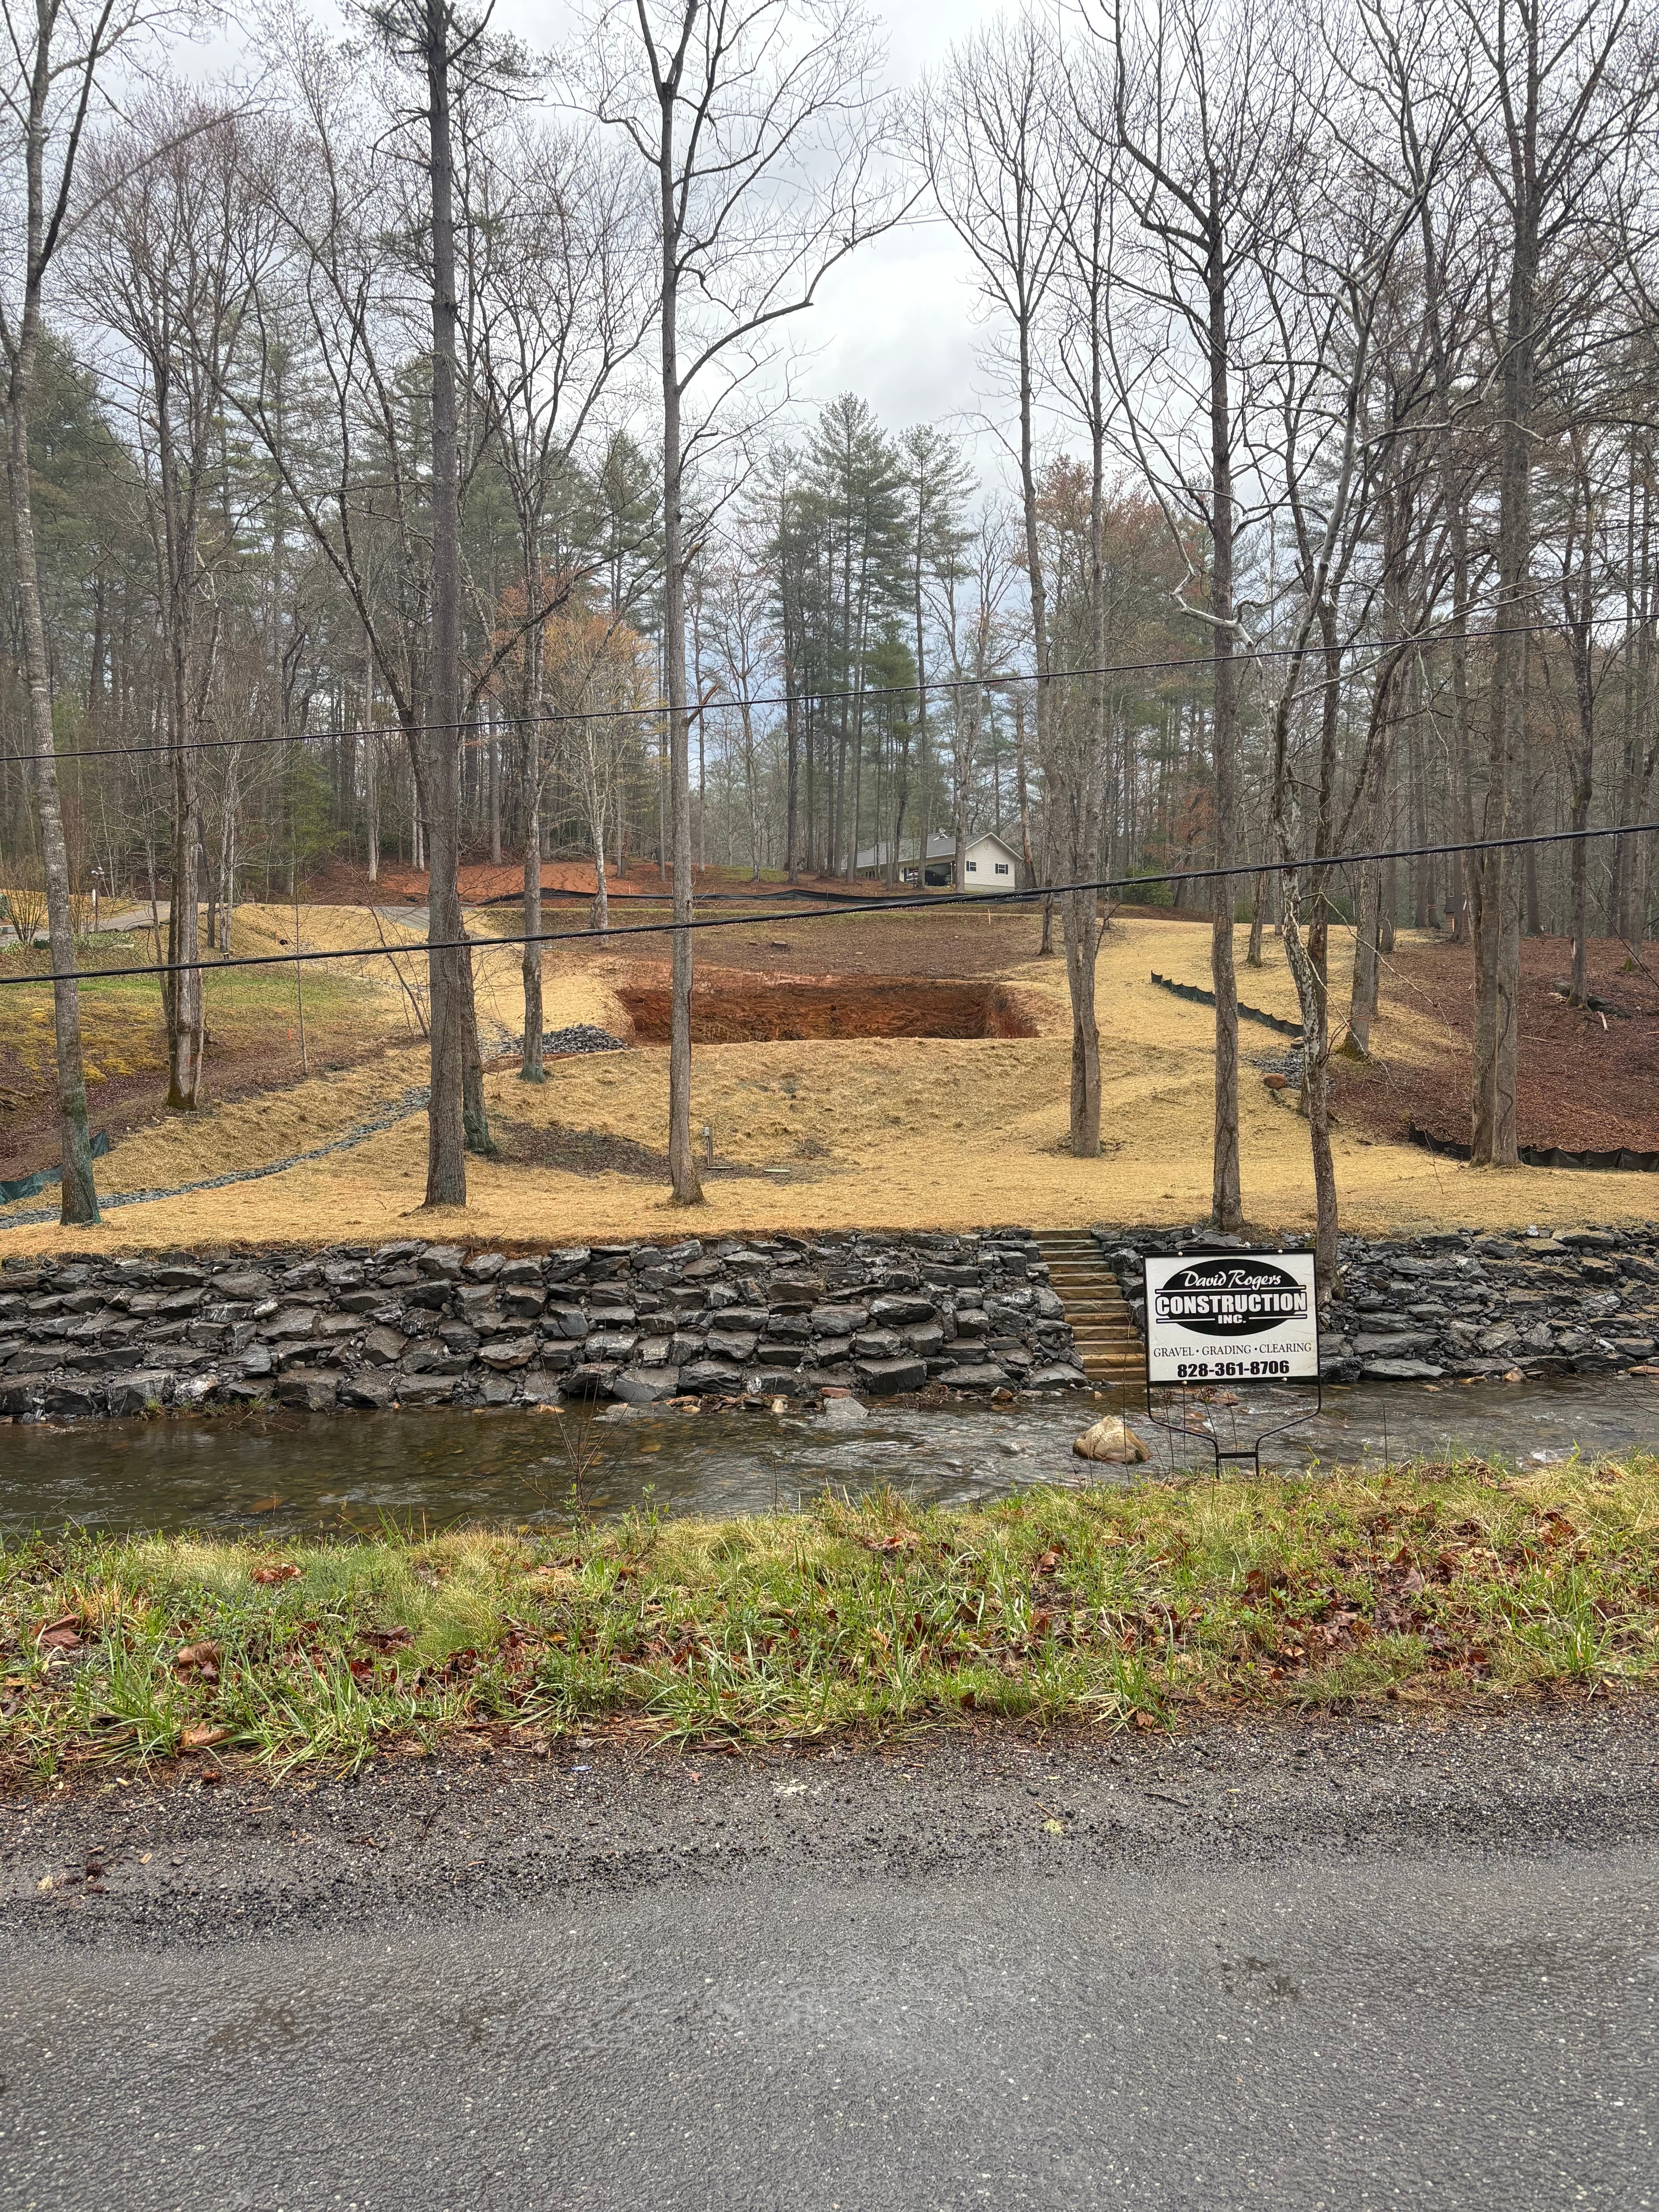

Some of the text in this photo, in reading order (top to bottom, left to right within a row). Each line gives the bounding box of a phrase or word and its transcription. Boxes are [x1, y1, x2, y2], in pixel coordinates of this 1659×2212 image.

[1180, 1270, 1281, 1290] David Rogers
[1156, 1293, 1306, 1315] CONSTRUCTION
[1218, 1315, 1247, 1324] INC.
[1154, 1343, 1312, 1357] GRAVEL GRADING CLEARING
[1177, 1360, 1290, 1378] 828-361-8706
